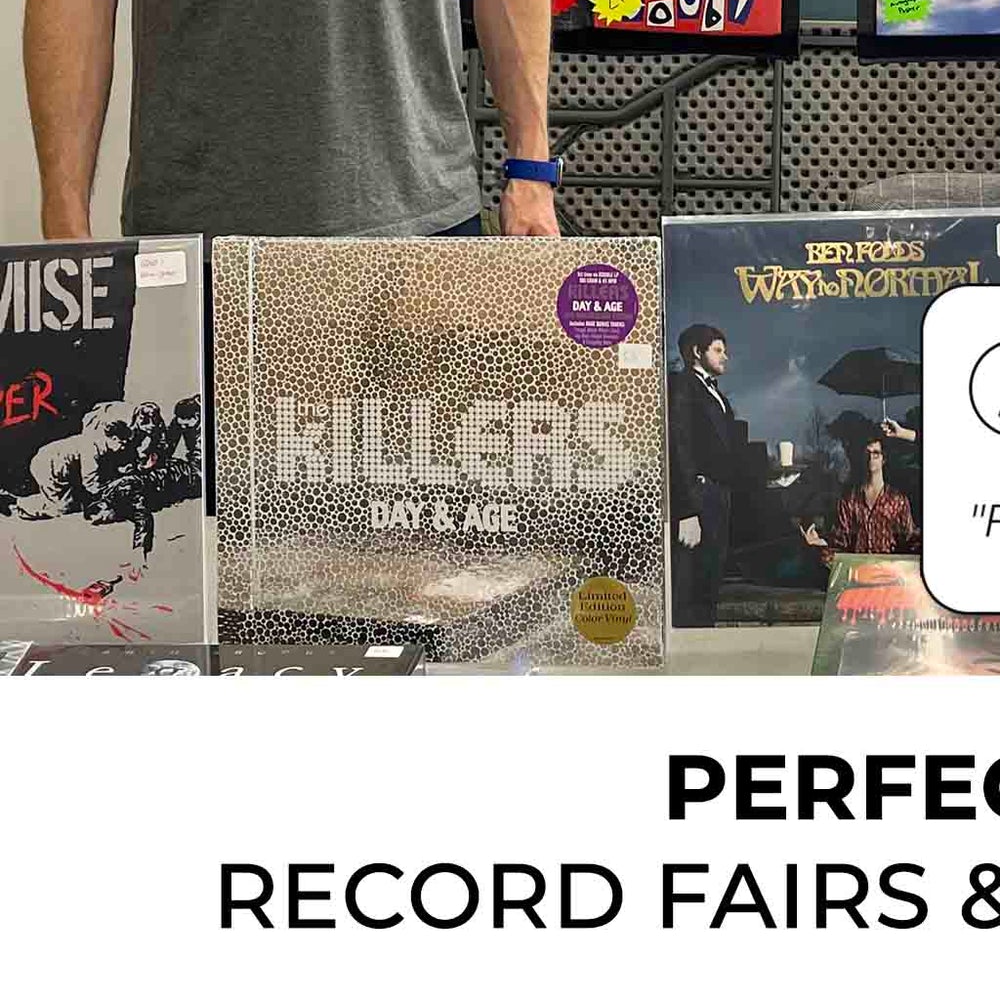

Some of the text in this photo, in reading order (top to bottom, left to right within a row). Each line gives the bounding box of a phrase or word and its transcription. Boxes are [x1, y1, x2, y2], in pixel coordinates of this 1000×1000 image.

[804, 240, 926, 265] BEN FOLDS
[734, 264, 820, 304] WAY
[572, 300, 623, 312] DAY & AGE
[274, 396, 639, 490] KILLERS
[370, 500, 519, 533] DAY & AGE
[578, 591, 627, 601] Limited
[580, 602, 626, 611] Edition
